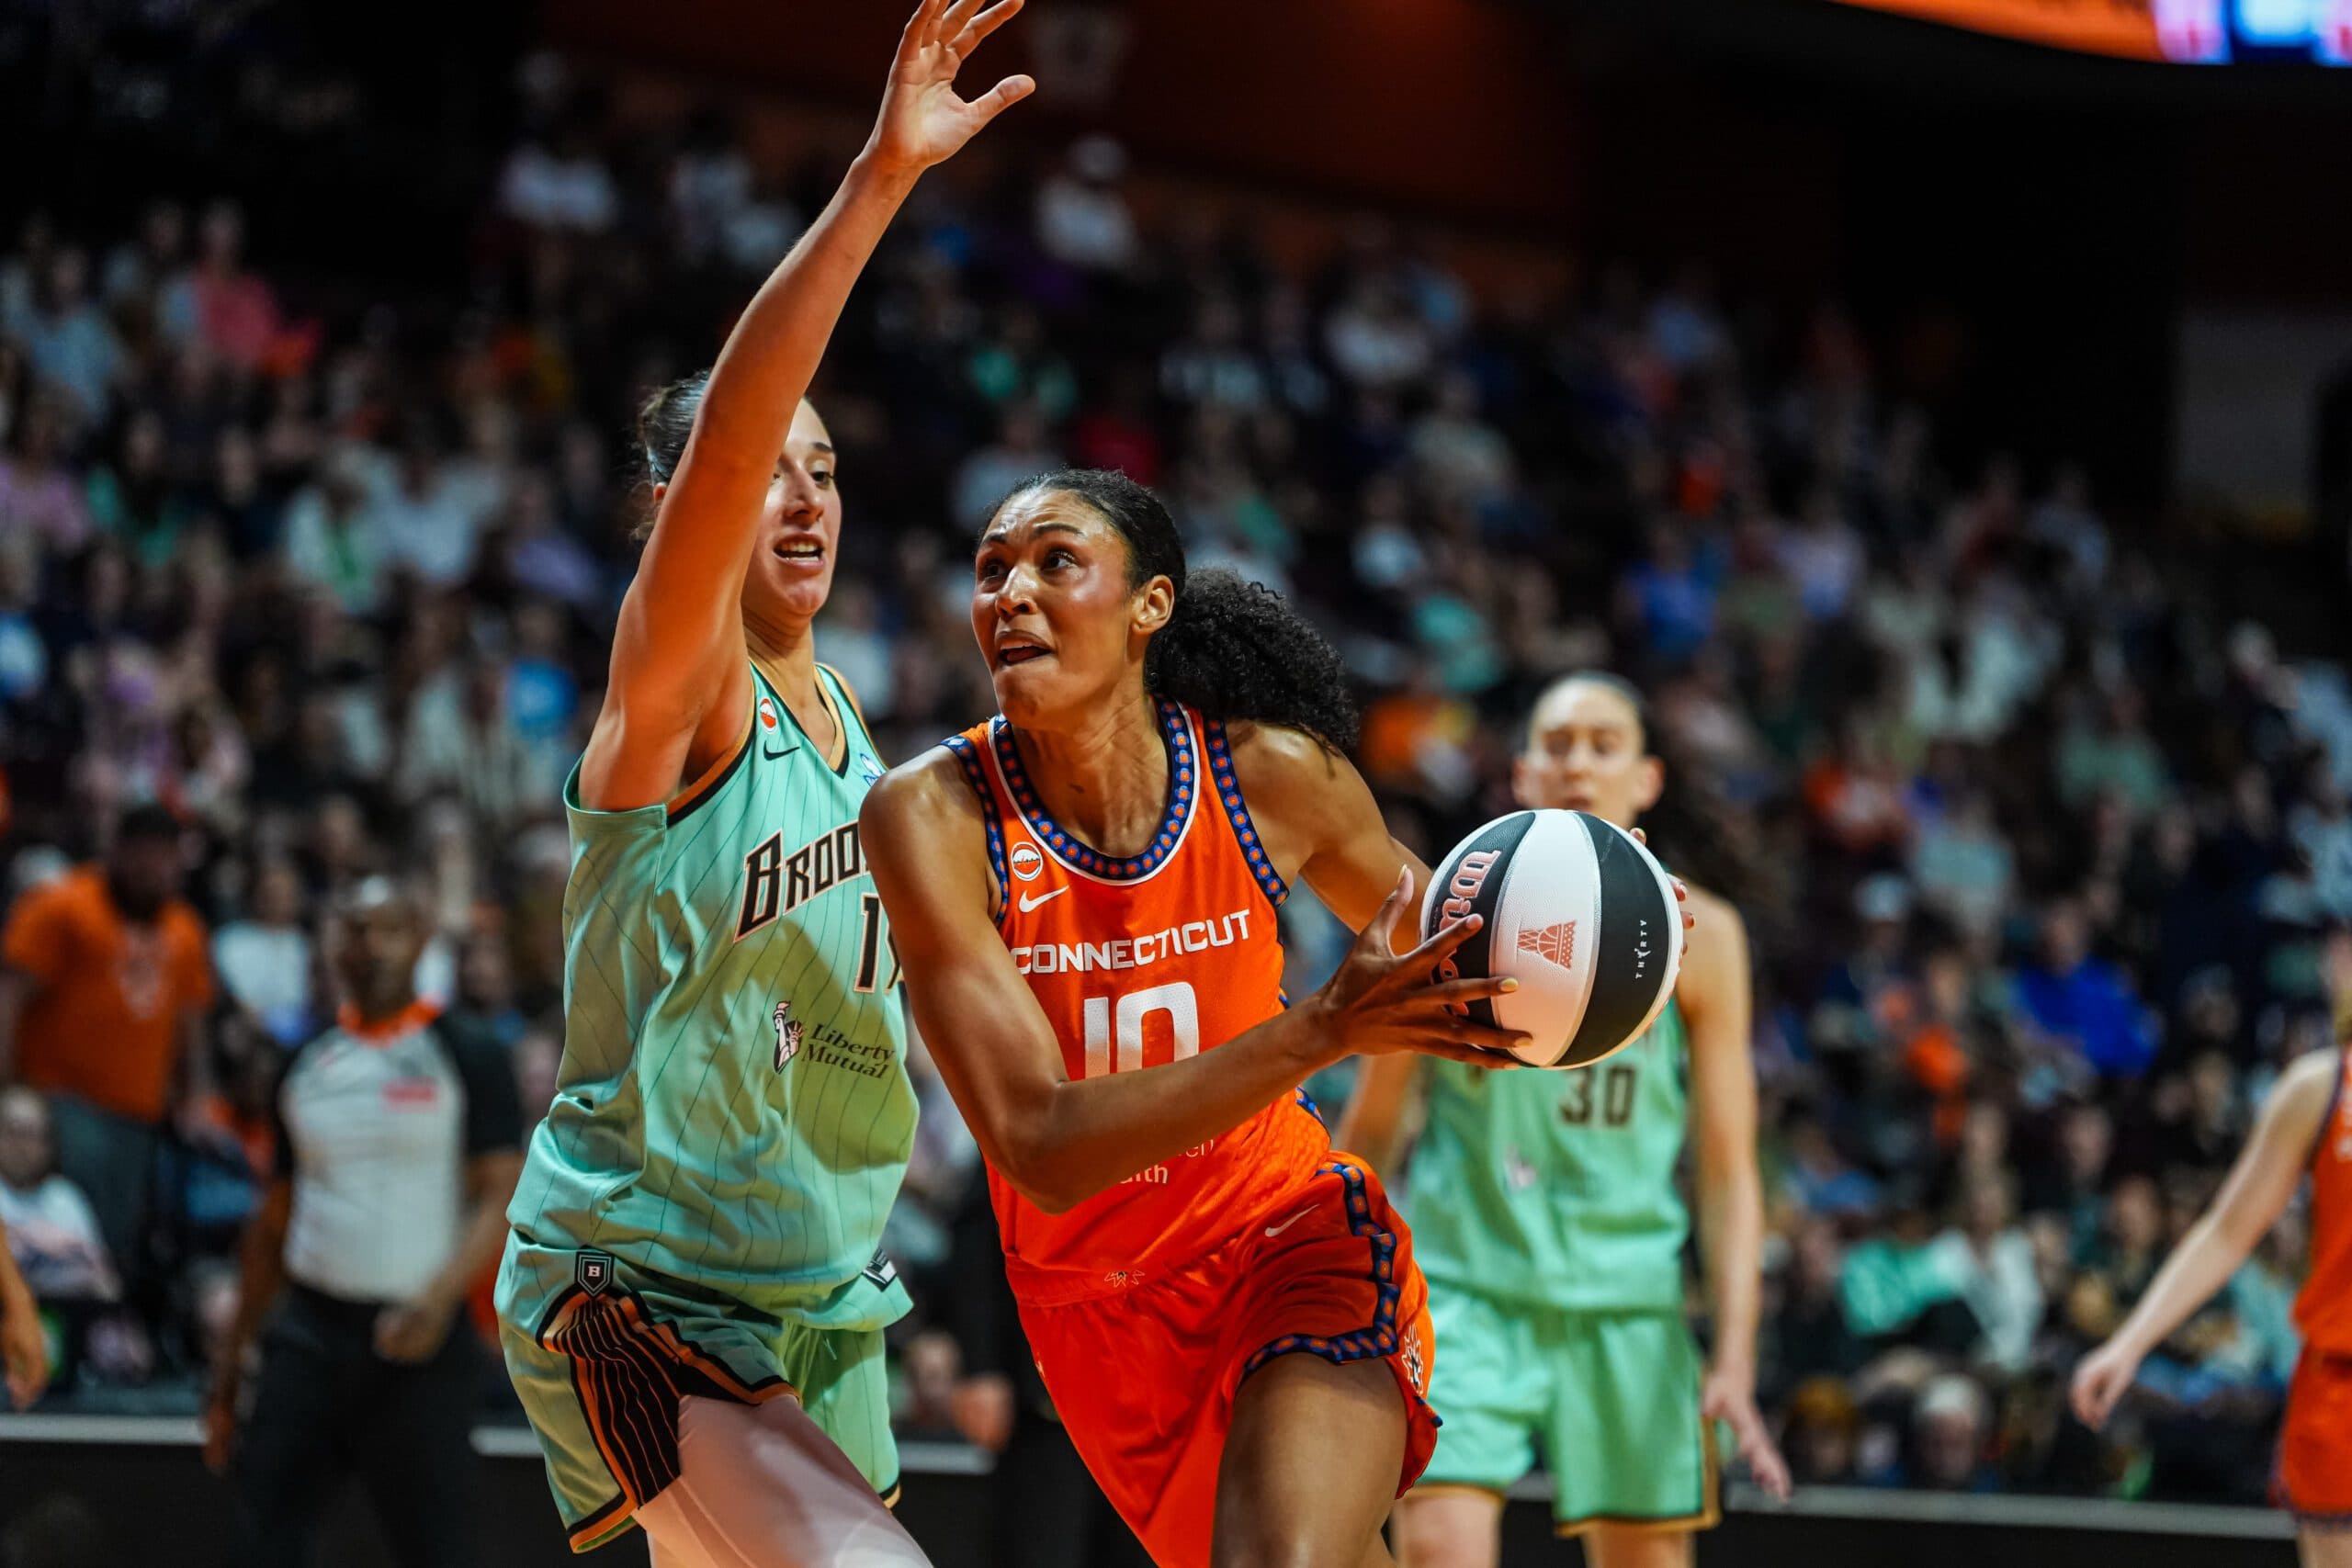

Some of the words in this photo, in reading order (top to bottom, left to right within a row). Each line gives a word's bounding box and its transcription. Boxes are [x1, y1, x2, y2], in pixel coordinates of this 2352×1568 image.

[1011, 909, 1250, 975] CONNECTICUT
[811, 1023, 896, 1061] Liberty
[1083, 982, 1200, 1079] 10
[801, 1043, 888, 1079] Mutual
[1558, 1063, 1637, 1127] 30
[588, 1266, 601, 1277] B
